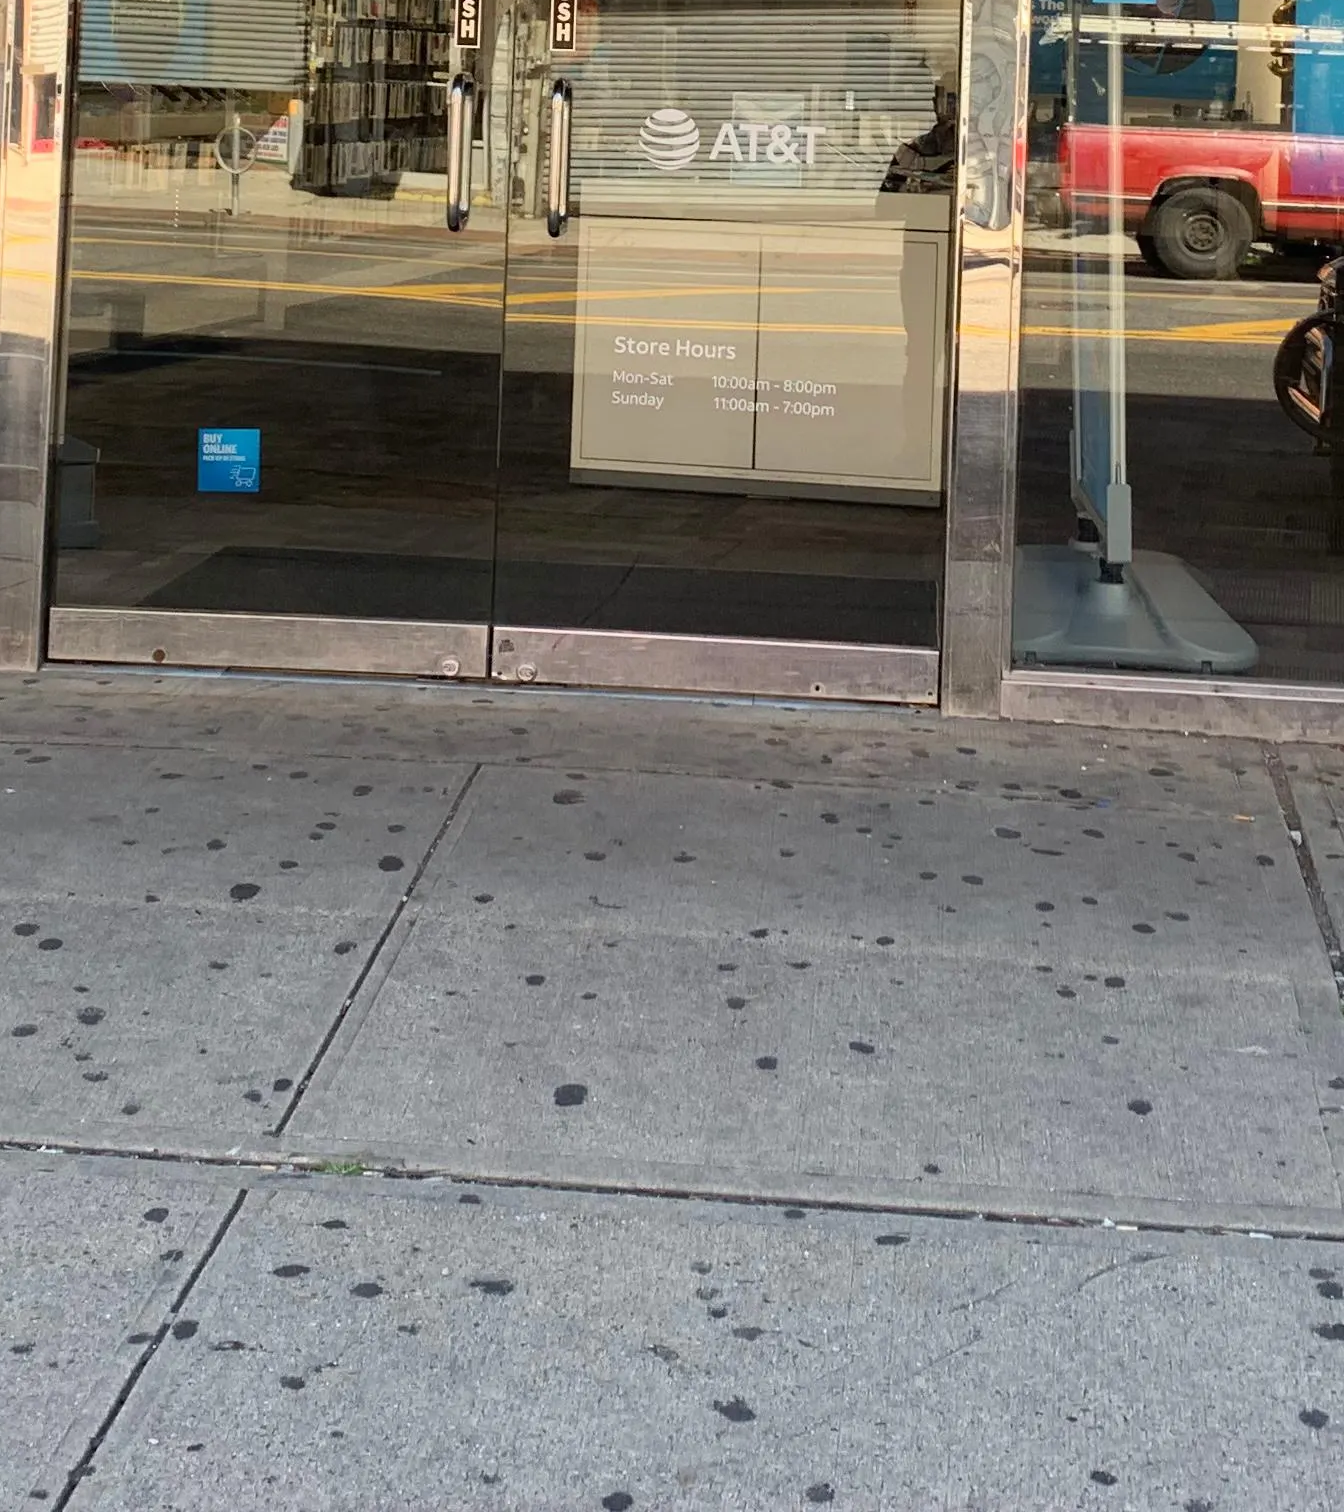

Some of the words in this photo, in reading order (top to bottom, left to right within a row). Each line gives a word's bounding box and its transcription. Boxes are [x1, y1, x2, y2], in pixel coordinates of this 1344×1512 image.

[709, 123, 827, 165] AT&T
[613, 335, 670, 356] Store
[676, 339, 737, 360] Hours
[612, 369, 674, 386] Mon-Sat
[711, 375, 770, 392] 10:00am
[783, 379, 837, 397] 8:00pm
[611, 391, 664, 409] Sunday
[713, 397, 769, 413] 11:00am
[782, 401, 835, 418] 7:00pm
[202, 444, 238, 455] ONLINE
[203, 433, 223, 444] BUY
